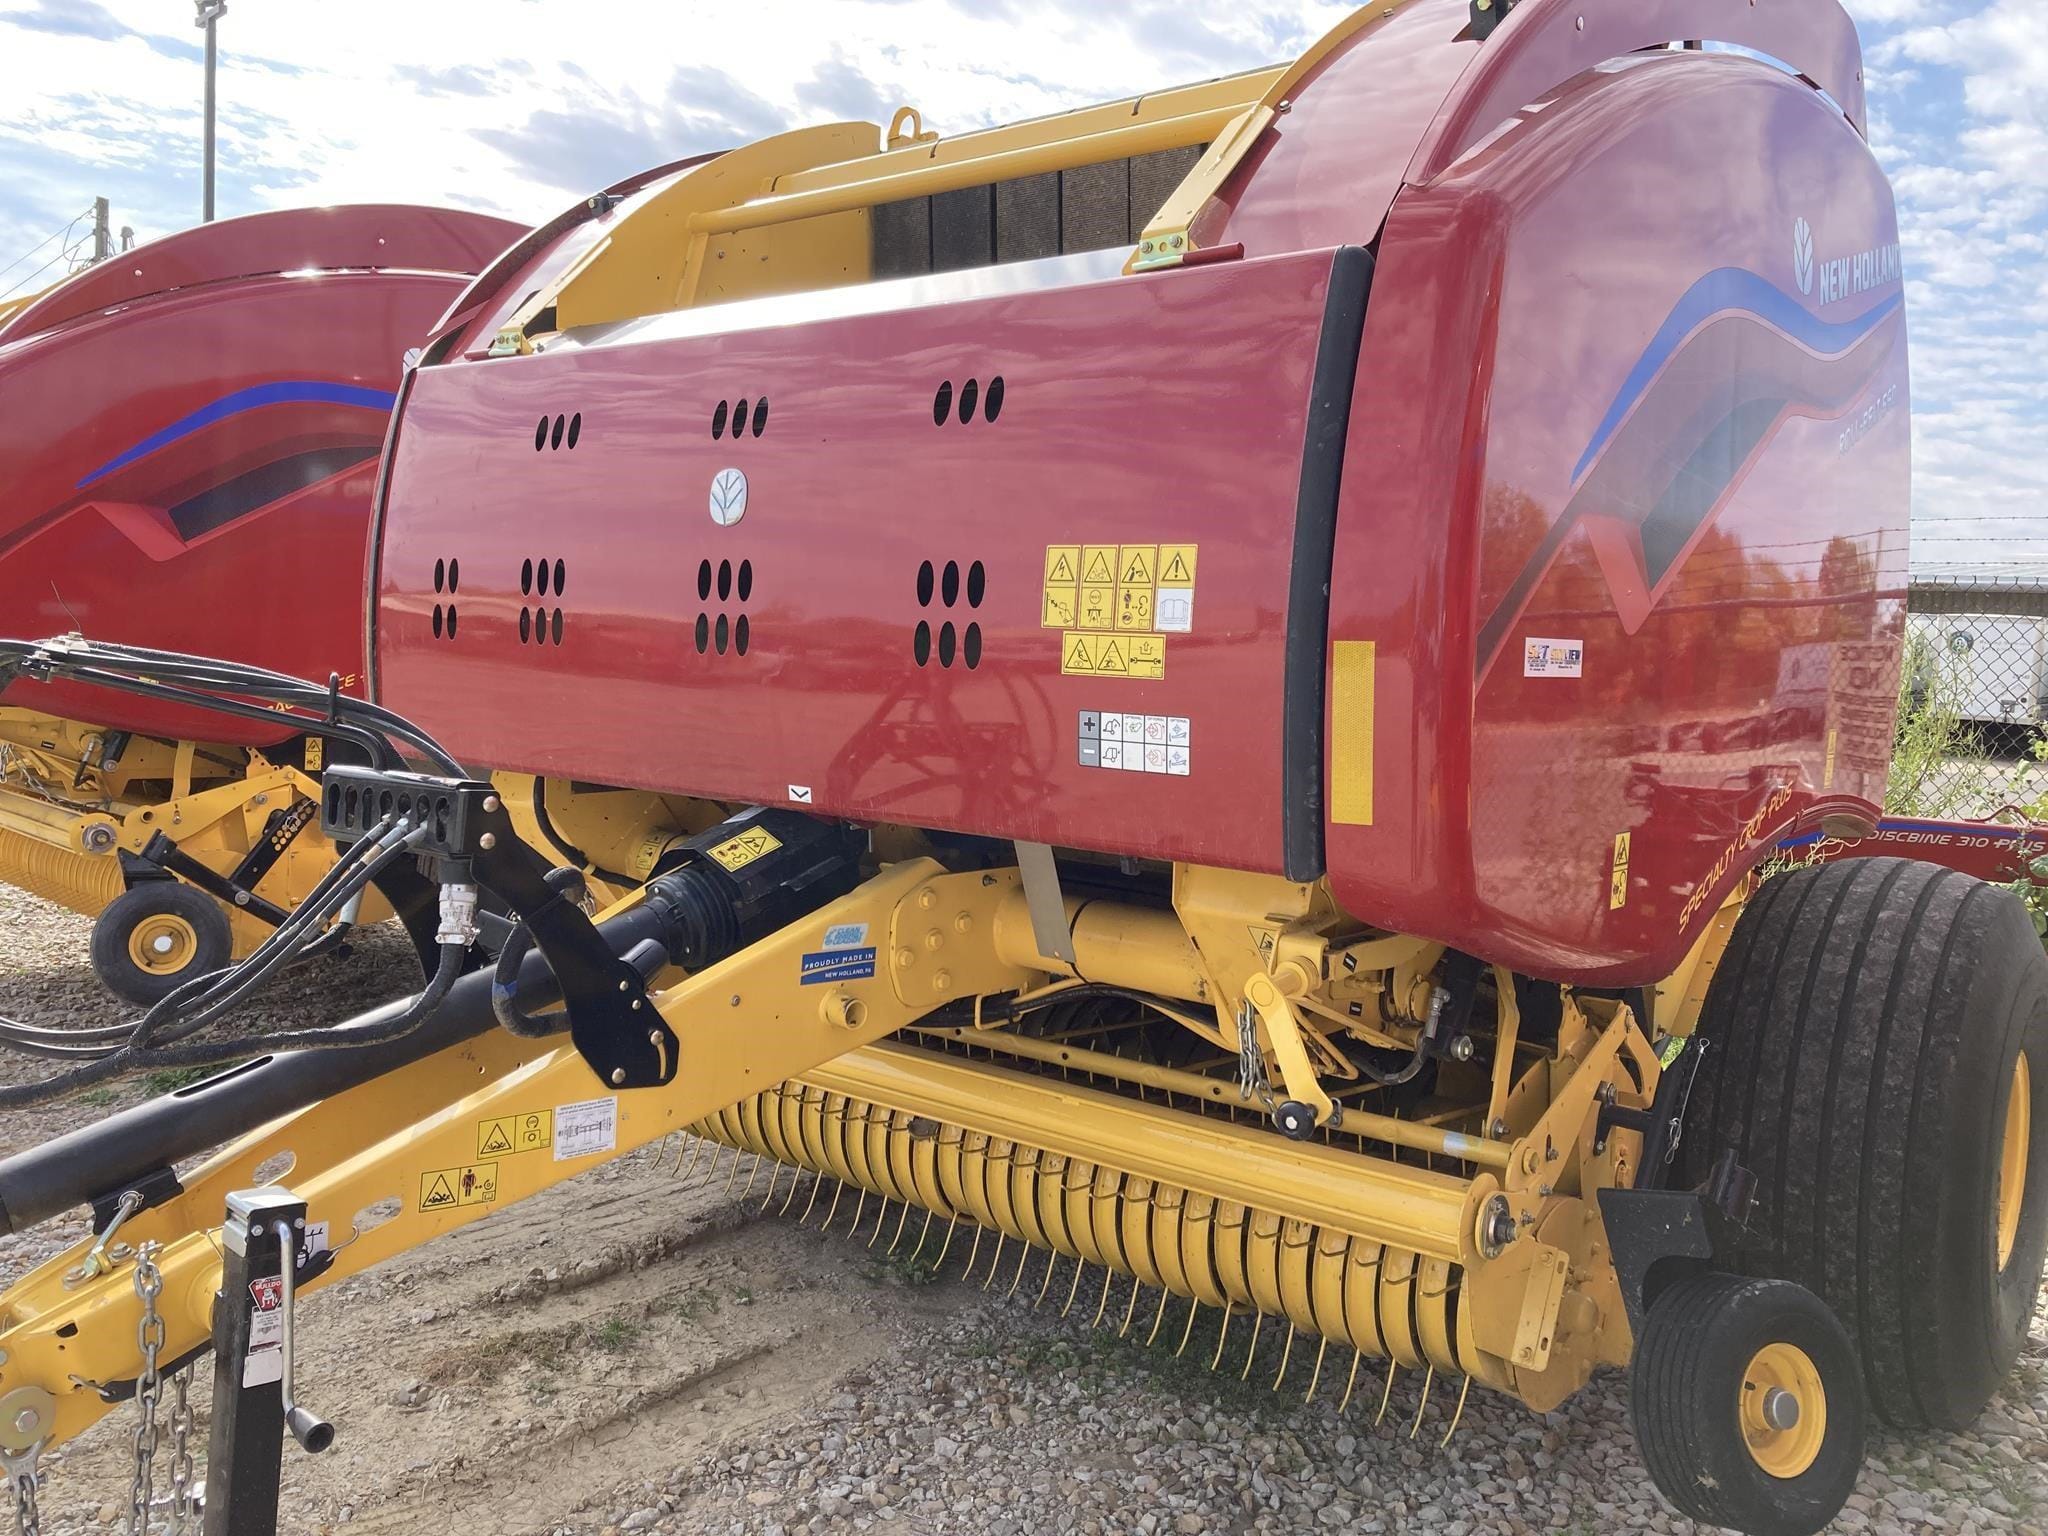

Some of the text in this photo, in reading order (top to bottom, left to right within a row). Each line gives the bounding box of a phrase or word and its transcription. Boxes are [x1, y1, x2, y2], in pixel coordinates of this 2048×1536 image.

[1819, 243, 1900, 306] NEW HOLLAND
[1866, 830, 1952, 846] DISCBINE
[1955, 836, 1990, 848] 310
[1679, 780, 1793, 935] SPECIALTY CROP PLUS
[804, 958, 840, 970] PROUDLY
[842, 954, 863, 963] MADE
[838, 969, 864, 977] HOLLAND,
[255, 1280, 281, 1290] BULLDO
